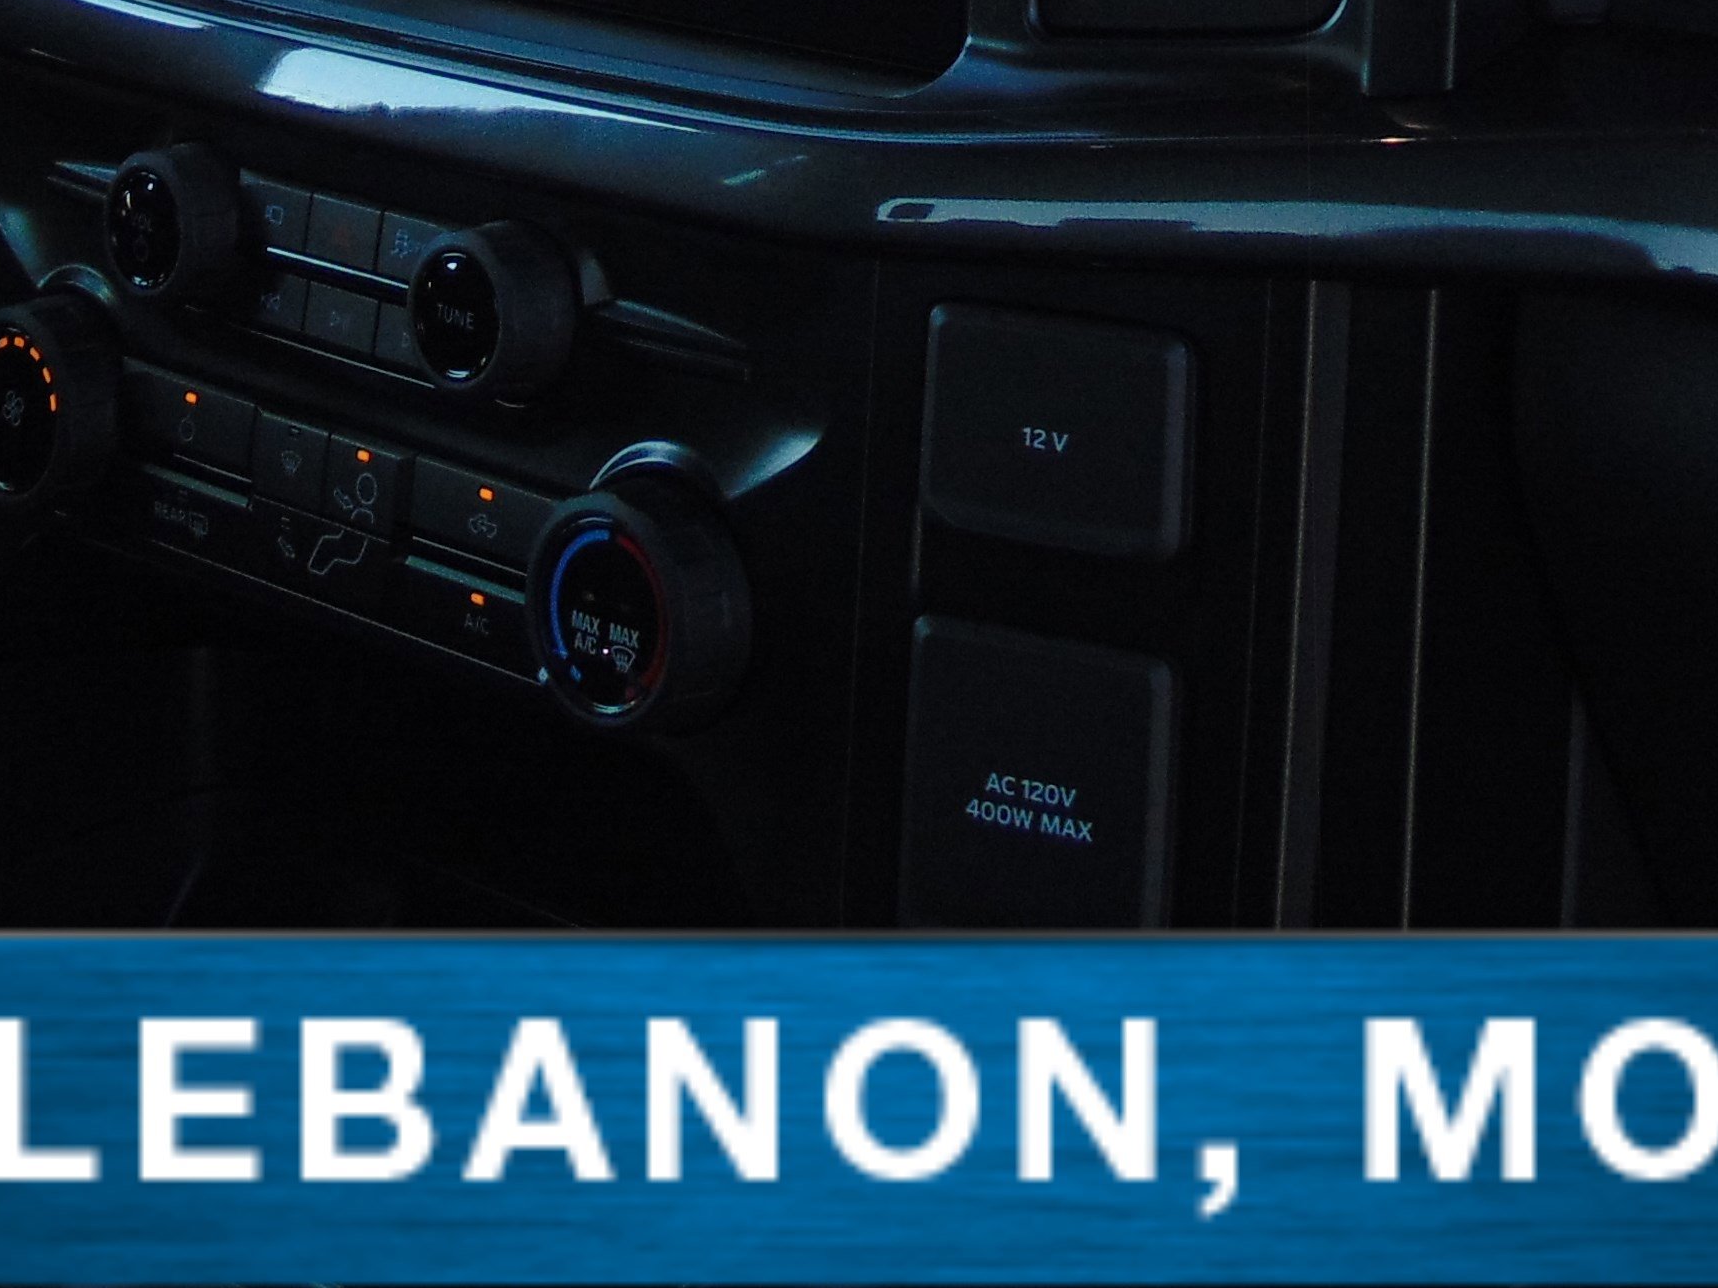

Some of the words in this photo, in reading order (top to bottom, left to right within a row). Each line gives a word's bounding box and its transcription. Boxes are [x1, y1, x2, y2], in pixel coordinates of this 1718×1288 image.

[437, 303, 476, 330] TUNE
[1021, 426, 1048, 451] 12
[1051, 431, 1070, 453] V
[571, 609, 601, 636] MAX
[609, 622, 640, 649] MAX
[984, 772, 1017, 799] AC
[1020, 777, 1077, 809] 120V
[965, 798, 1035, 832] 400W
[1039, 812, 1094, 843] MAX
